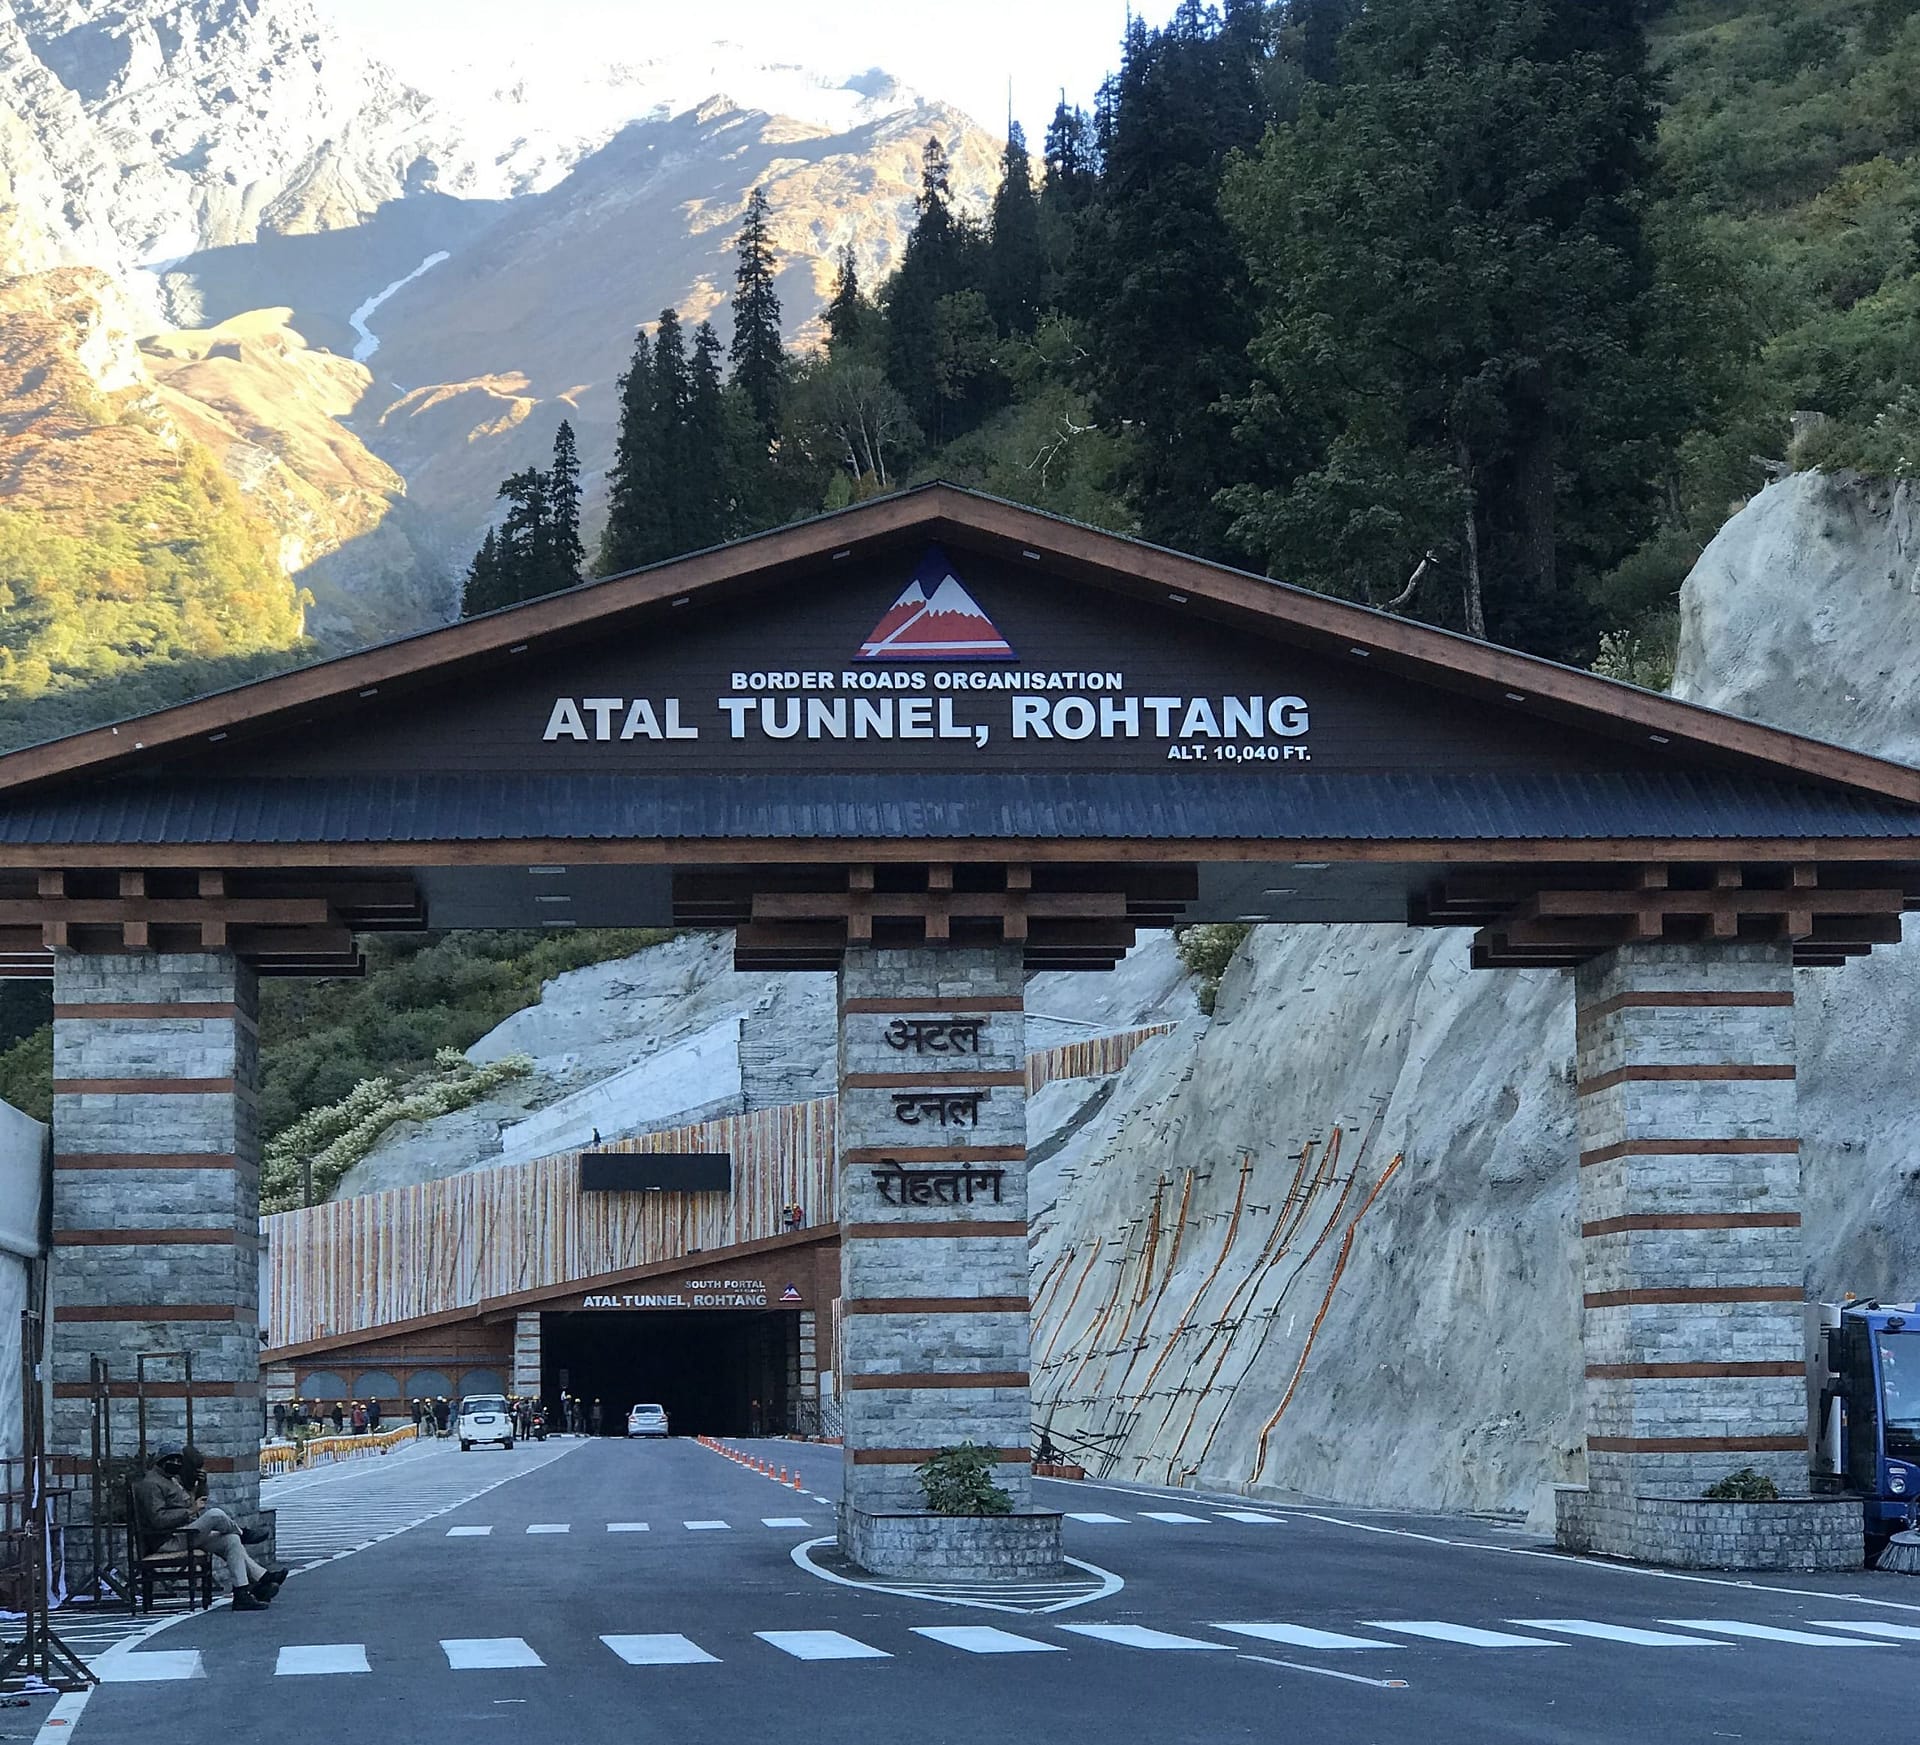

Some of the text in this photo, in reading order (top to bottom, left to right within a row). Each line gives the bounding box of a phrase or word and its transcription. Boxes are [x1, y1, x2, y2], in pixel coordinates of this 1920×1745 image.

[732, 672, 1123, 690] BORDER ROADS ORGANISATION
[542, 696, 1309, 748] ATAL TUNNEL, ROHTANG
[1167, 745, 1311, 762] ALT. 10,040 FT.
[885, 1018, 986, 1053] अटल
[892, 1092, 984, 1126] टनल
[871, 1158, 1005, 1203] रोहतांग
[685, 1280, 766, 1289] SOUTH PORTAL
[583, 1294, 767, 1308] ATAL TUNNEL, ROHTANG
